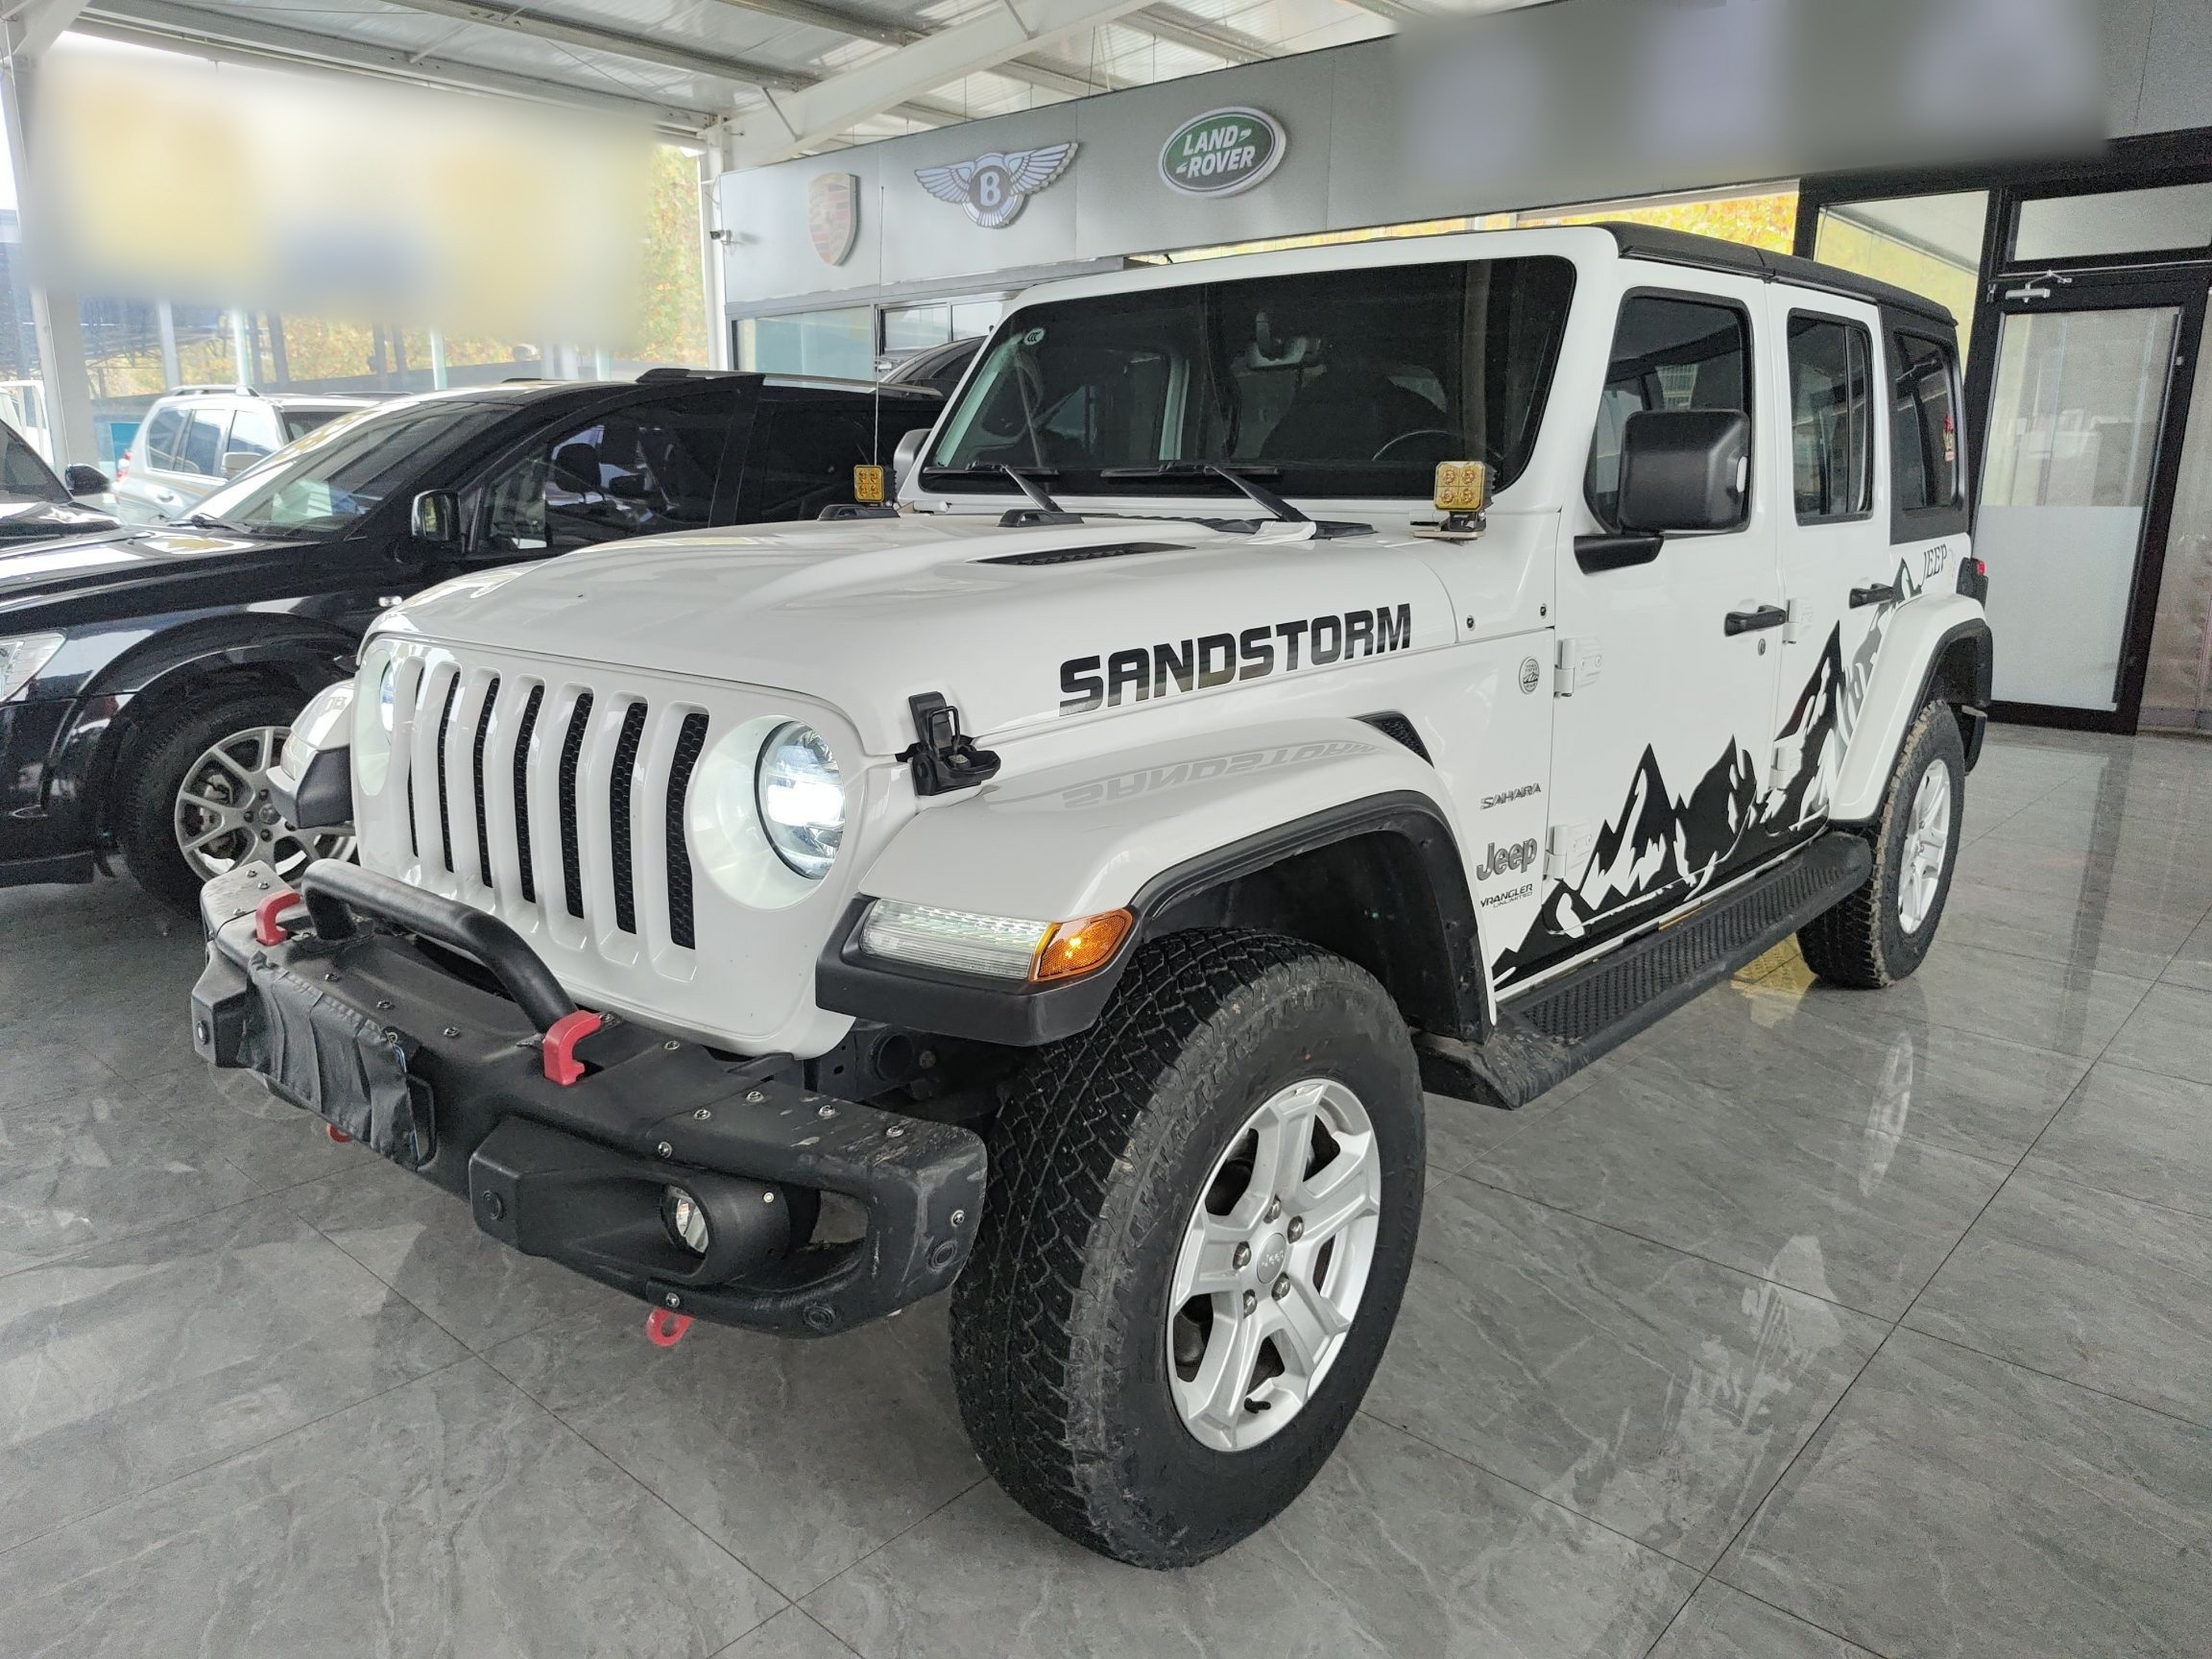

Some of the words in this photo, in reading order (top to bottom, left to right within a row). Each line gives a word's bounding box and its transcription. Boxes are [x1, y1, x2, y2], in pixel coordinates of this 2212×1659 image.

[1183, 124, 1238, 157] LAND
[1187, 145, 1256, 179] ROVER
[980, 171, 1001, 207] B
[1919, 543, 1948, 585] JEEP
[1059, 603, 1411, 717] SANDSTORM
[1480, 783, 1541, 810] SAHARA
[1476, 838, 1537, 881] Jeep
